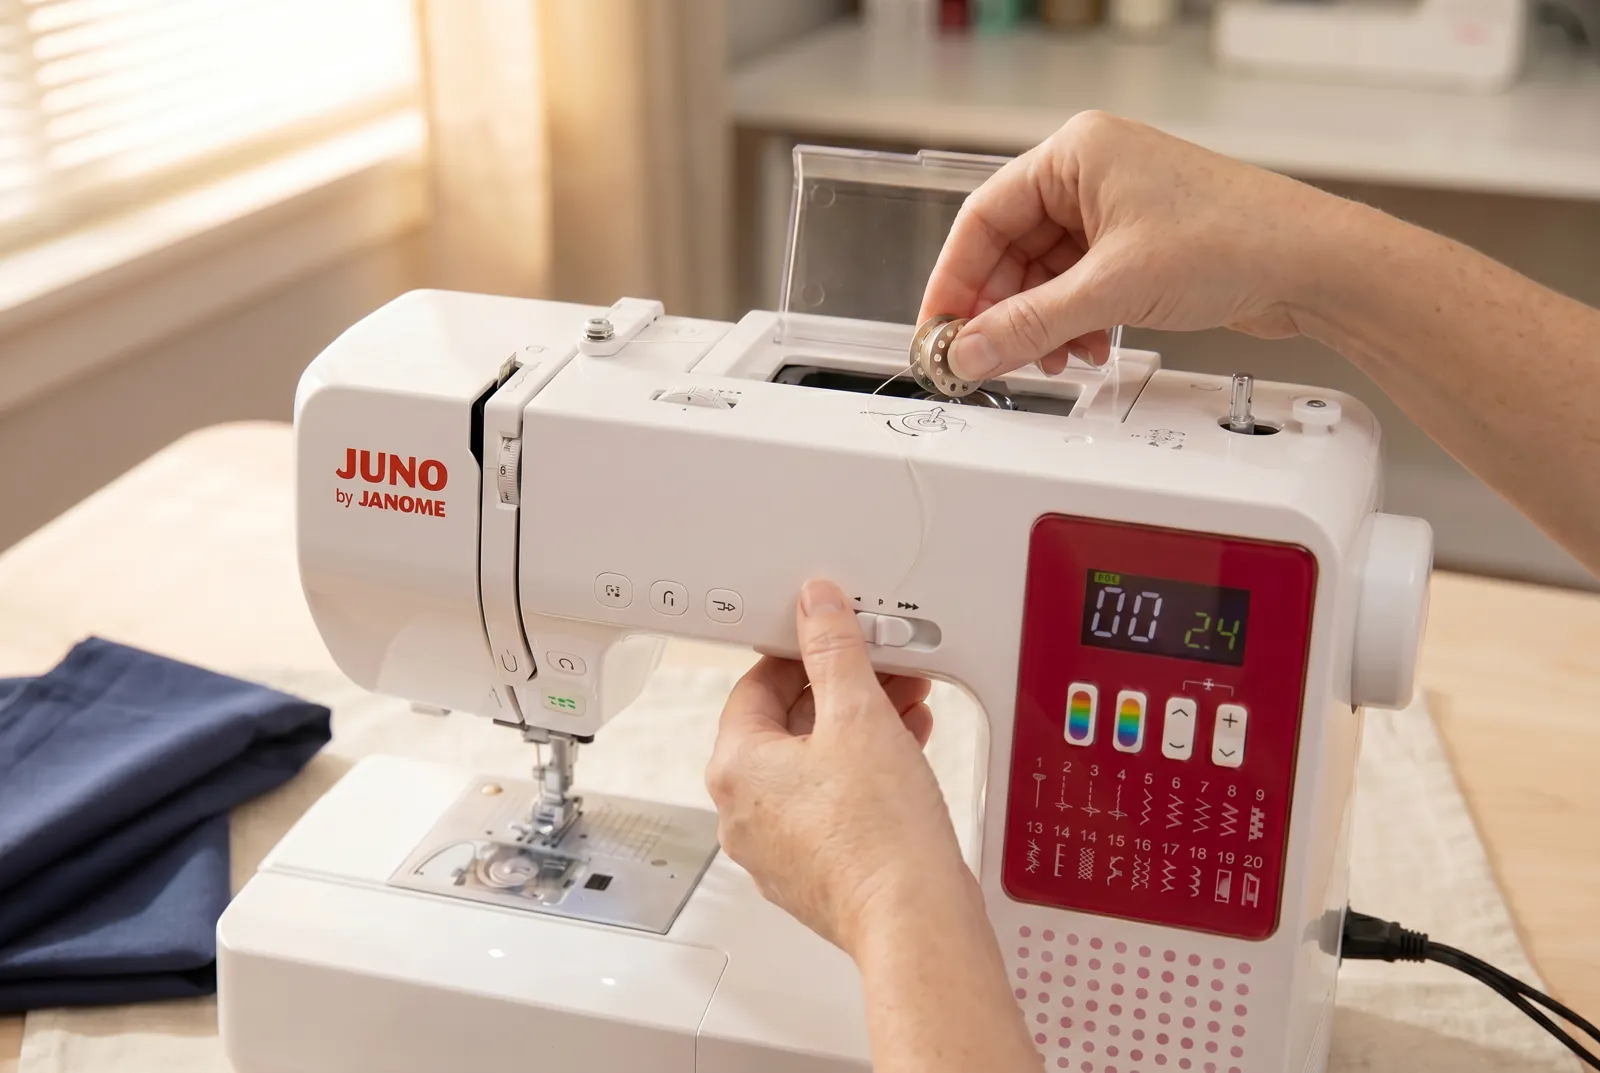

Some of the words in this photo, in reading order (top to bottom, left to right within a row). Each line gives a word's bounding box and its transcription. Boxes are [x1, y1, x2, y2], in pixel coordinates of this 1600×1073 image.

[336, 448, 448, 491] JUNO
[500, 465, 506, 475] 6
[336, 488, 353, 508] by
[359, 490, 446, 518] JANOME
[1090, 586, 1163, 642] 00
[1037, 757, 1042, 768] 1
[1062, 761, 1072, 772] 2
[1089, 765, 1099, 776] 3
[1116, 769, 1127, 781] 4
[1144, 773, 1153, 784] 5
[1171, 777, 1181, 789] 6
[1200, 781, 1210, 793] 7
[1227, 785, 1237, 797] 8
[1255, 789, 1265, 801] 9
[1026, 821, 1043, 833] 13
[1053, 826, 1071, 838] 14
[1080, 830, 1097, 842] 14
[1107, 834, 1125, 847] 15
[1134, 838, 1152, 851] 16
[1161, 843, 1180, 855] 17
[1189, 847, 1207, 859] 18
[1217, 852, 1235, 864] 19
[1243, 855, 1263, 868] 20
